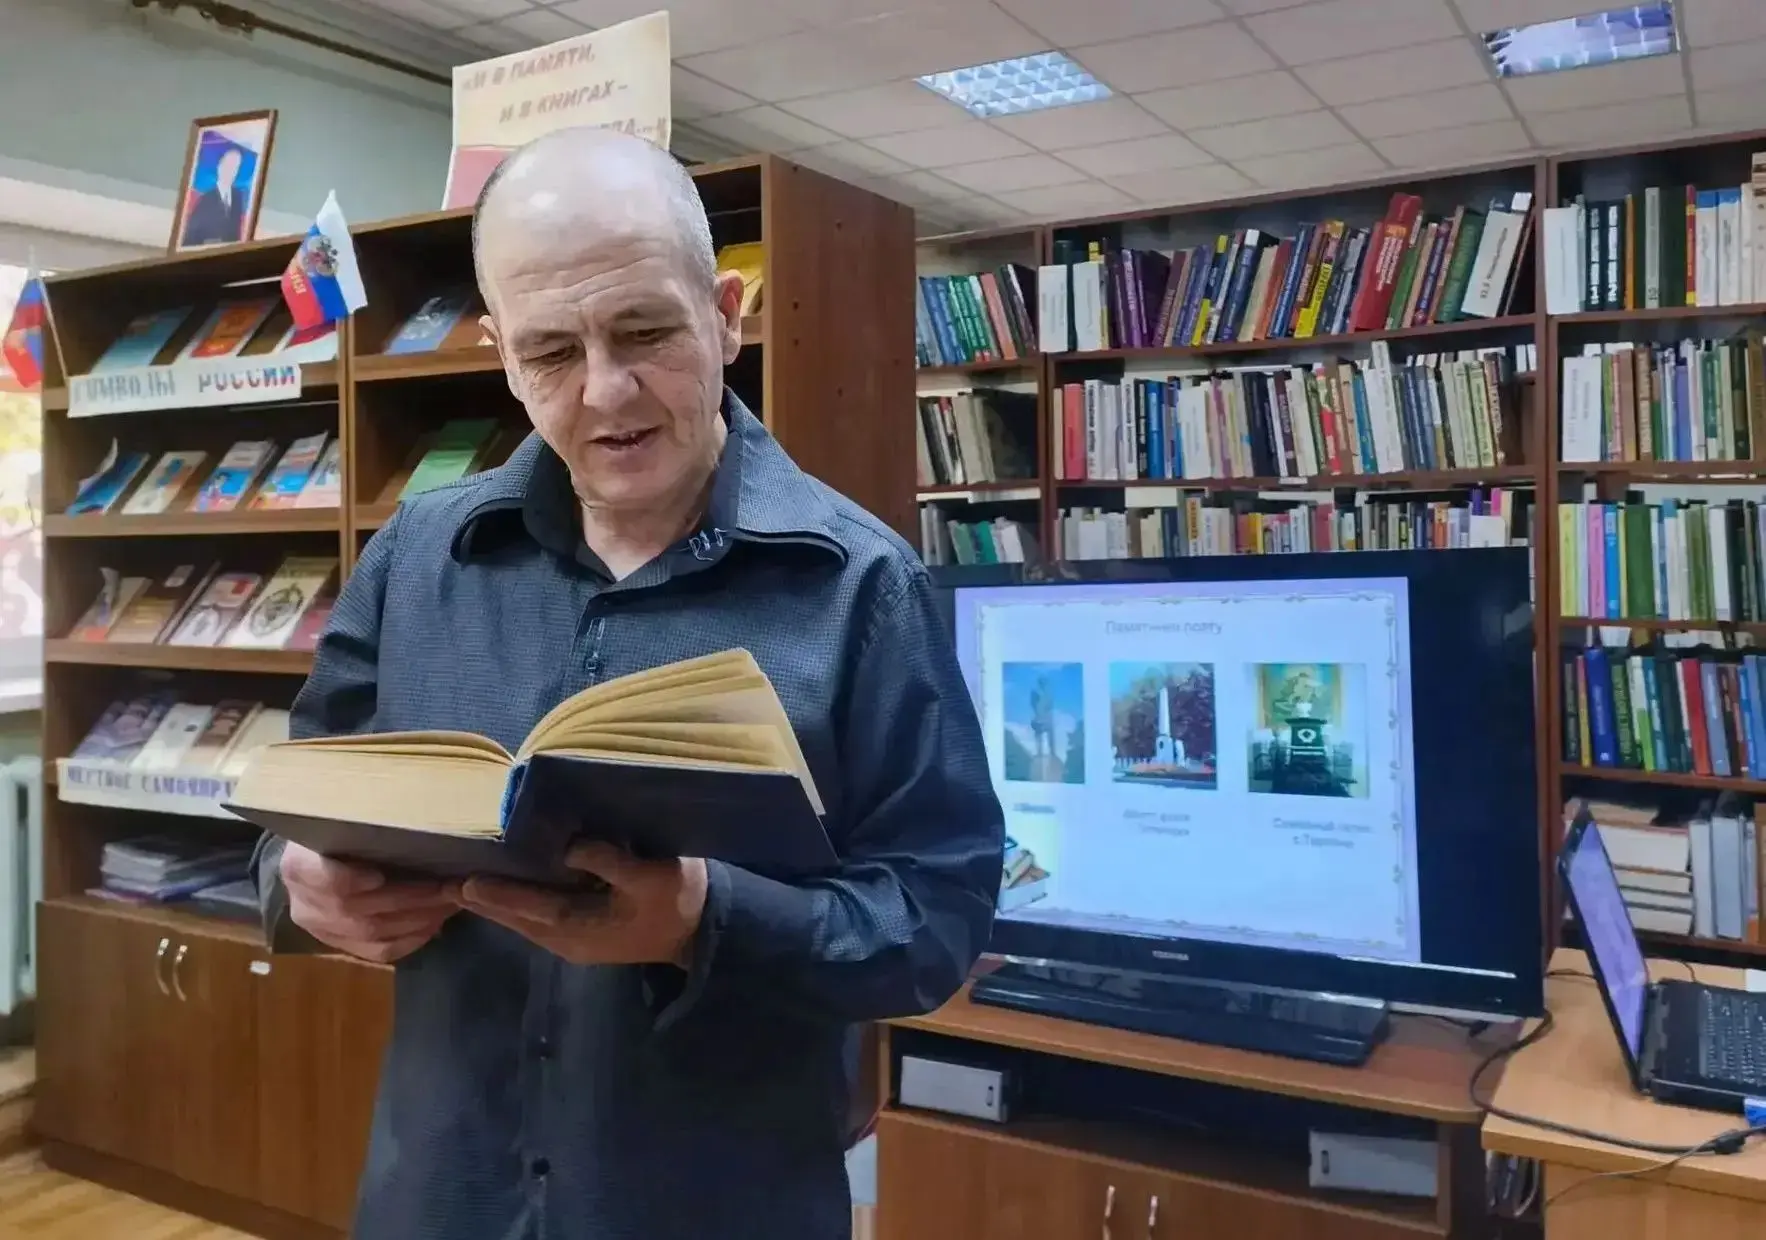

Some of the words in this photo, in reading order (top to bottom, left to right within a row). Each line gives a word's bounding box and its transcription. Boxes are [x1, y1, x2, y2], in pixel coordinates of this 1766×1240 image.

[492, 66, 505, 85] В
[509, 43, 596, 81] ПАМЯТИ,
[499, 106, 514, 123] И
[518, 100, 531, 118] В
[537, 79, 615, 114] КНИГАХ
